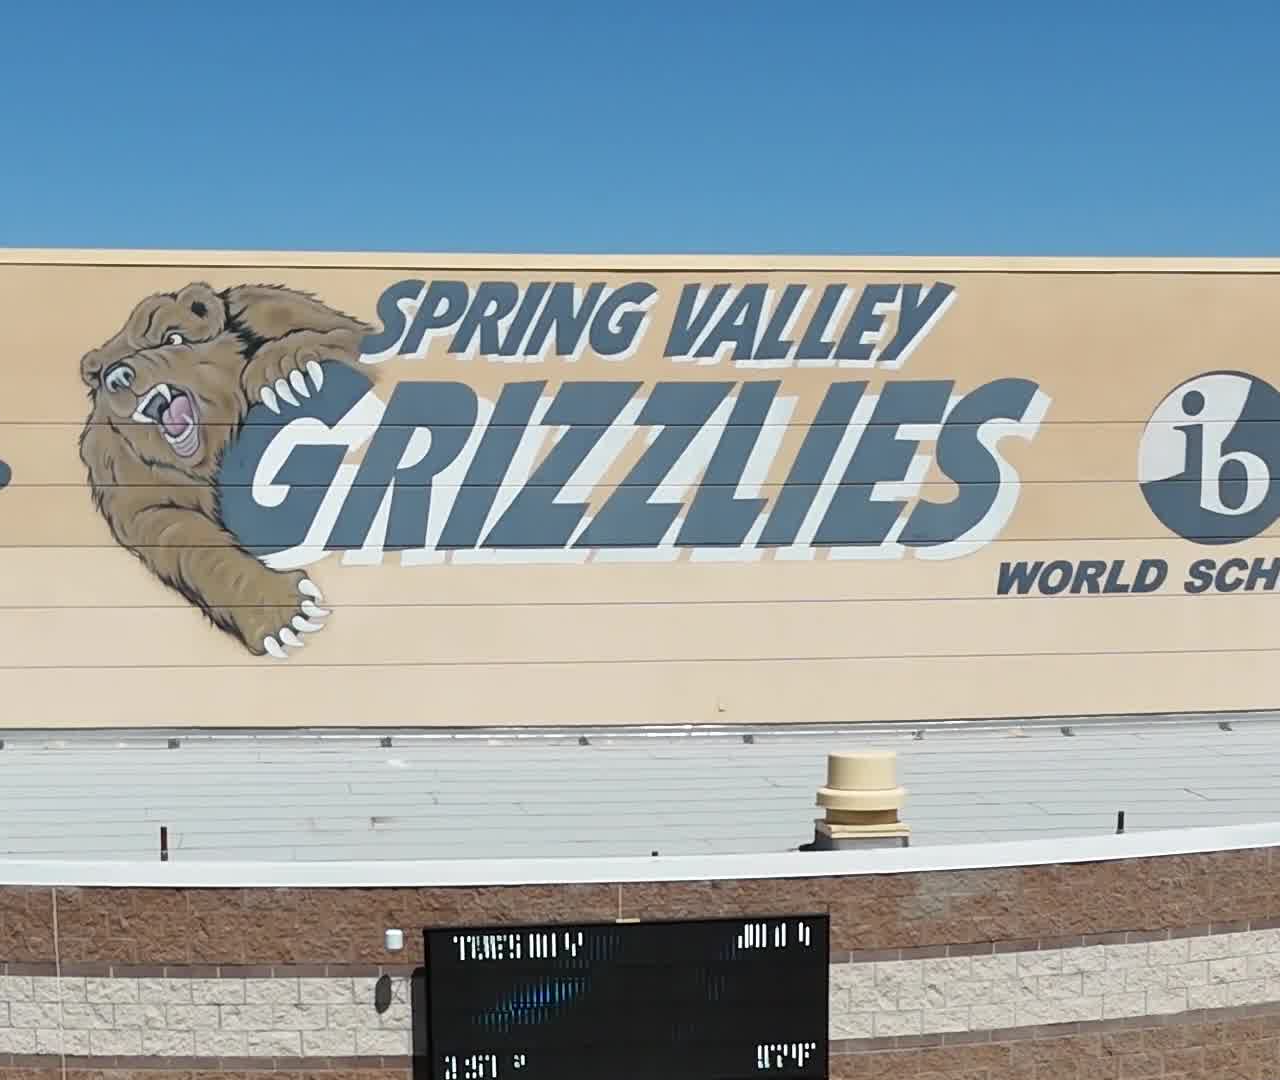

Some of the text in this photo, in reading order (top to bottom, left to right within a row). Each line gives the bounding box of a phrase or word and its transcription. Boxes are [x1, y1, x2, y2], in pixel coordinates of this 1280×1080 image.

[360, 279, 960, 367] SPRING VALLEY
[220, 377, 1050, 565] GRIZZLIES
[1172, 390, 1271, 516] ib
[996, 559, 1169, 595] WORLD
